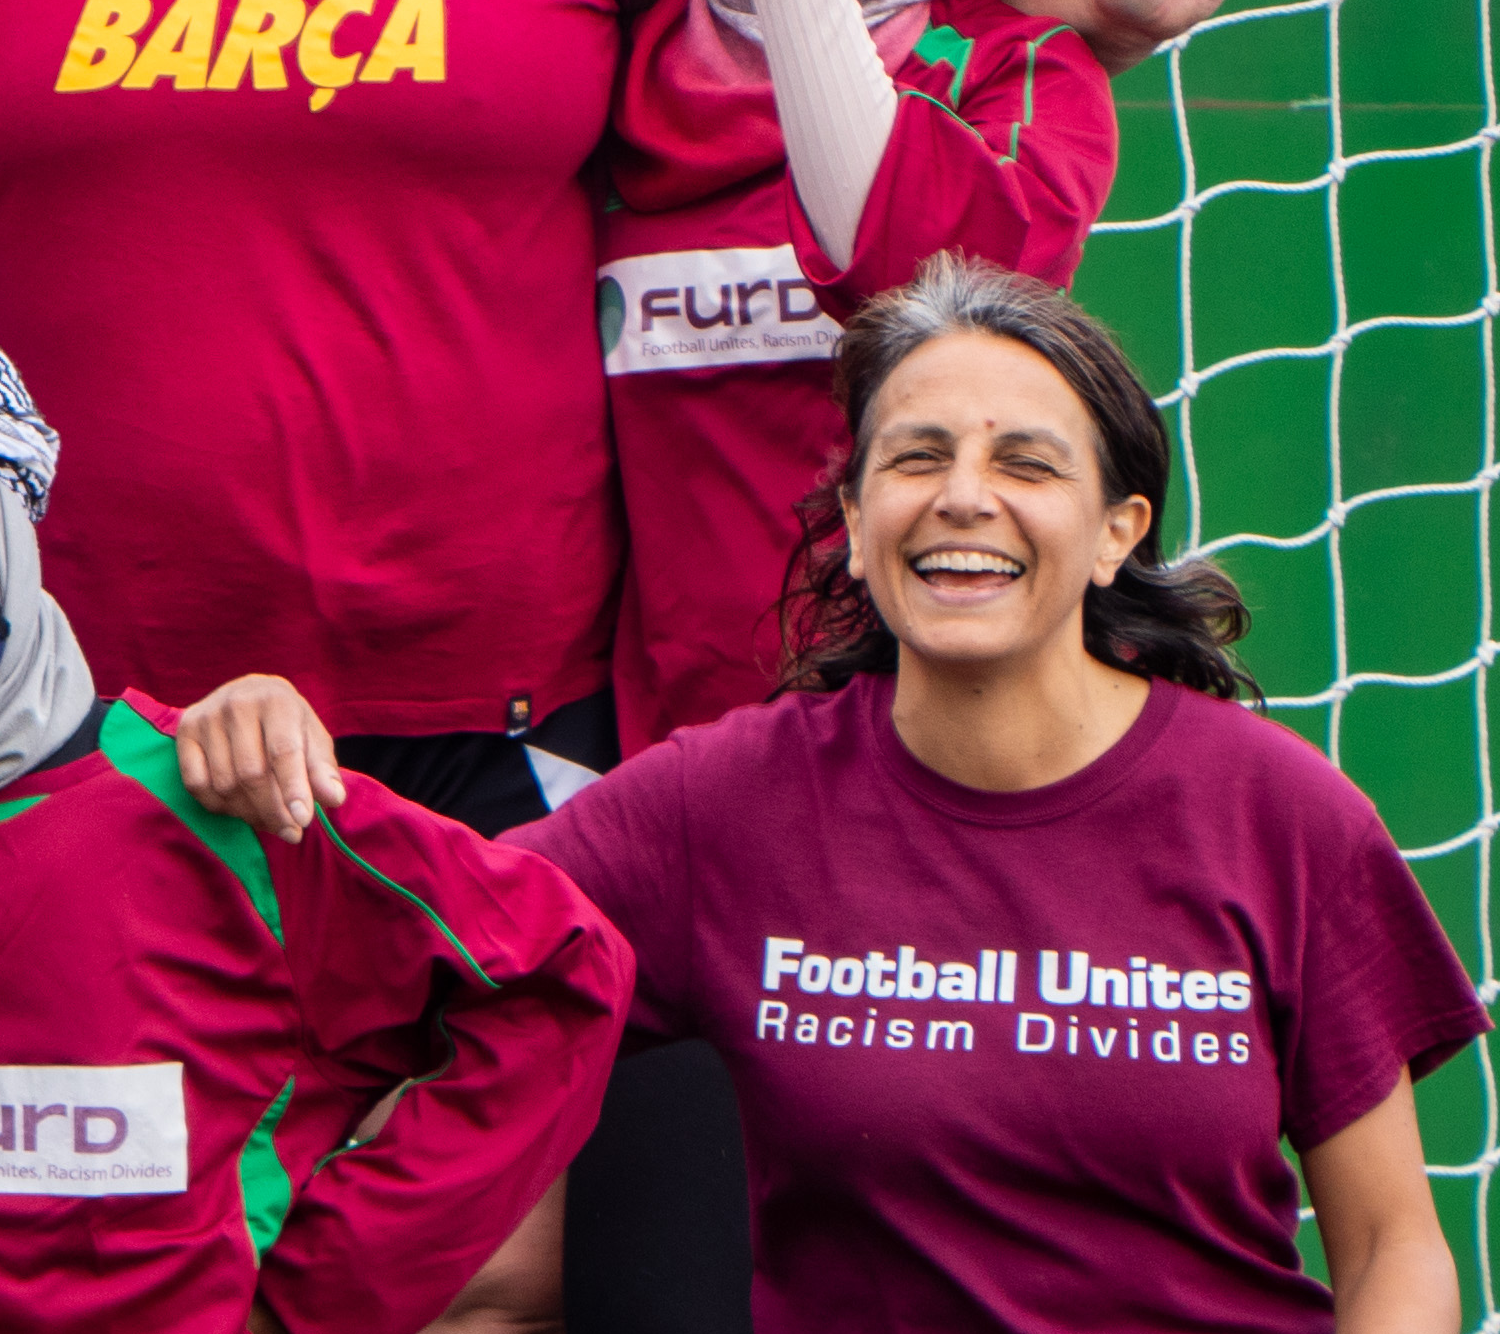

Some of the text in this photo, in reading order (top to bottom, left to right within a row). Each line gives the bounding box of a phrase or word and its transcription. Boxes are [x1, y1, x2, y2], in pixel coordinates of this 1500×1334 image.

[643, 337, 706, 357] Football
[763, 333, 812, 348] Racism
[763, 936, 1252, 1011] Football Unites
[756, 999, 1251, 1064] Racism Divides
[48, 1164, 108, 1182] Racism
[111, 1163, 173, 1179] Divides
